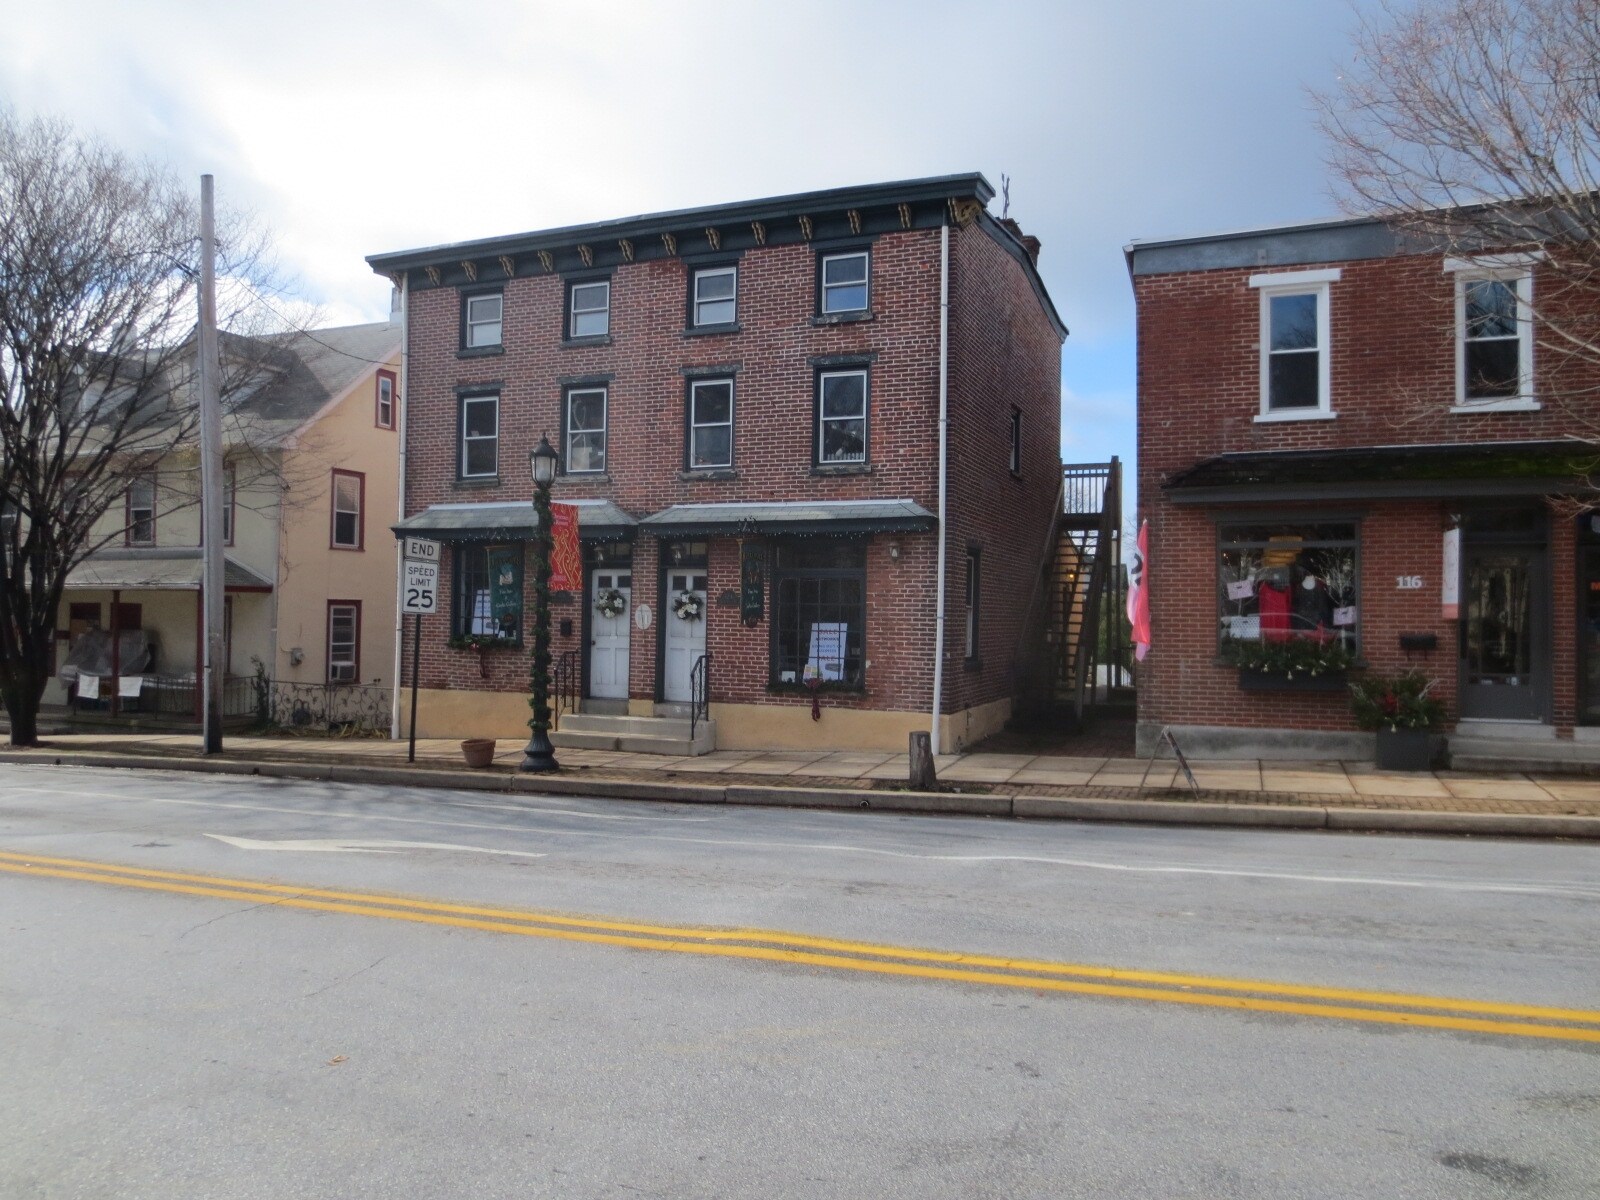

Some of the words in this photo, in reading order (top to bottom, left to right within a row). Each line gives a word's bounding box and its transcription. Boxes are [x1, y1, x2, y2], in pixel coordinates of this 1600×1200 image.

[412, 543, 434, 557] END
[408, 566, 435, 577] SPEED
[411, 578, 432, 588] LIMIT
[1396, 576, 1422, 588] 116
[407, 588, 433, 608] 25
